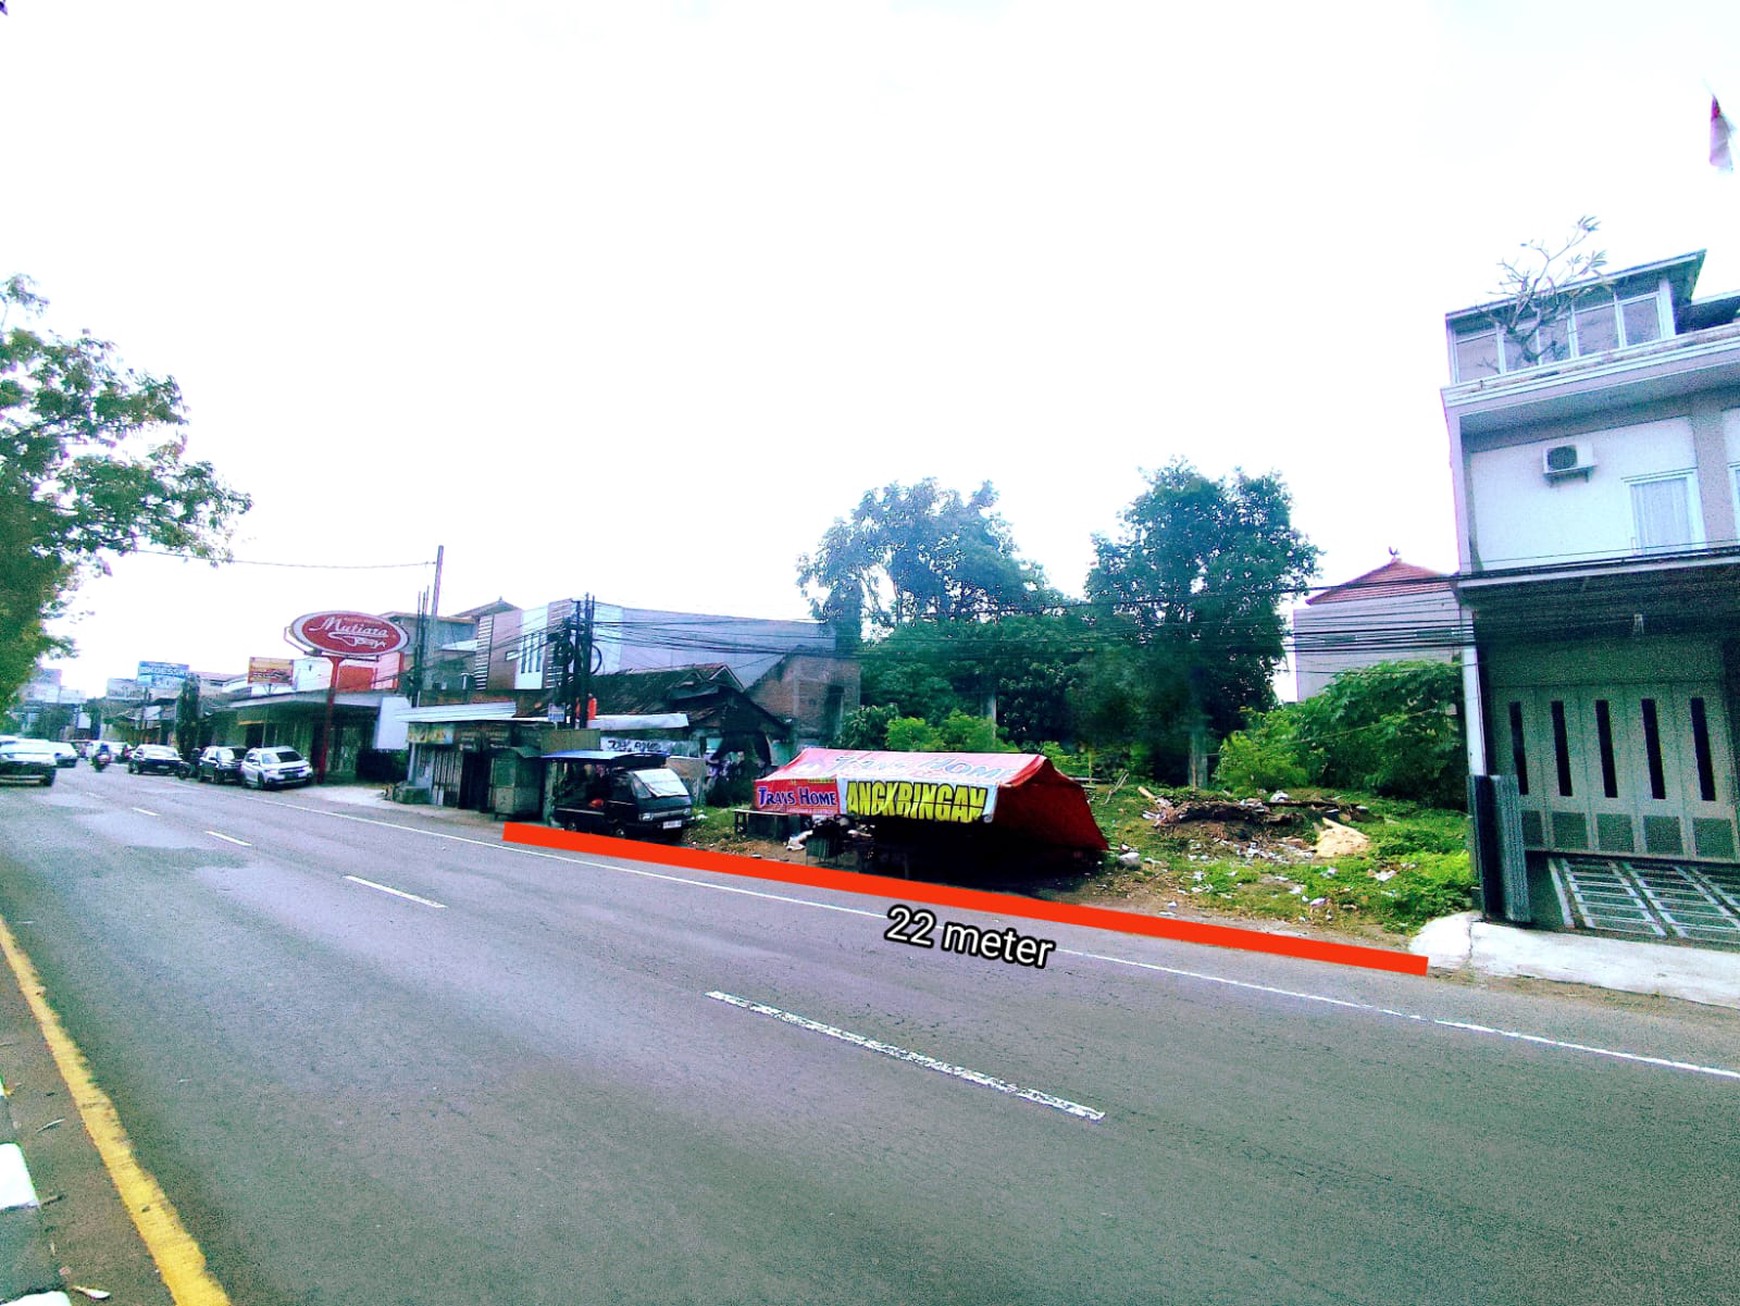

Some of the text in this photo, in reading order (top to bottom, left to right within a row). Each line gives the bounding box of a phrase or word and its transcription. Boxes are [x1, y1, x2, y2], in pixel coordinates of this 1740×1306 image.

[758, 785, 837, 808] TRANS HOME
[846, 780, 988, 823] ANGKRINGAN
